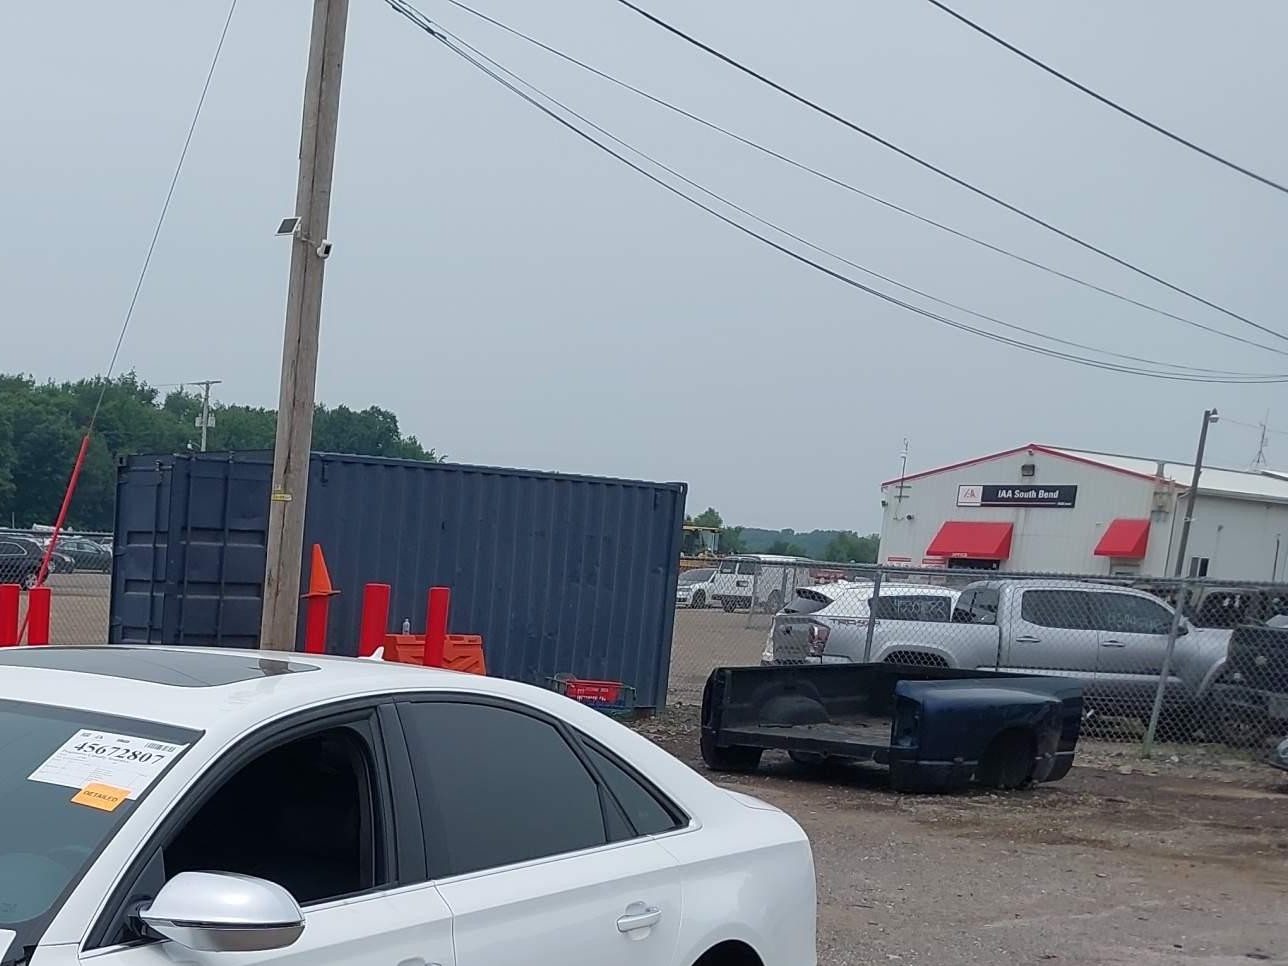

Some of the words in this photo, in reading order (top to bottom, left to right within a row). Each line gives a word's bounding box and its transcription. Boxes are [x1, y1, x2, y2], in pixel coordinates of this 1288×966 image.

[998, 489, 1012, 498] IAA
[1014, 489, 1036, 499] South
[1038, 489, 1059, 499] Bend
[74, 741, 165, 765] 45672807
[83, 790, 118, 802] DETAILED
